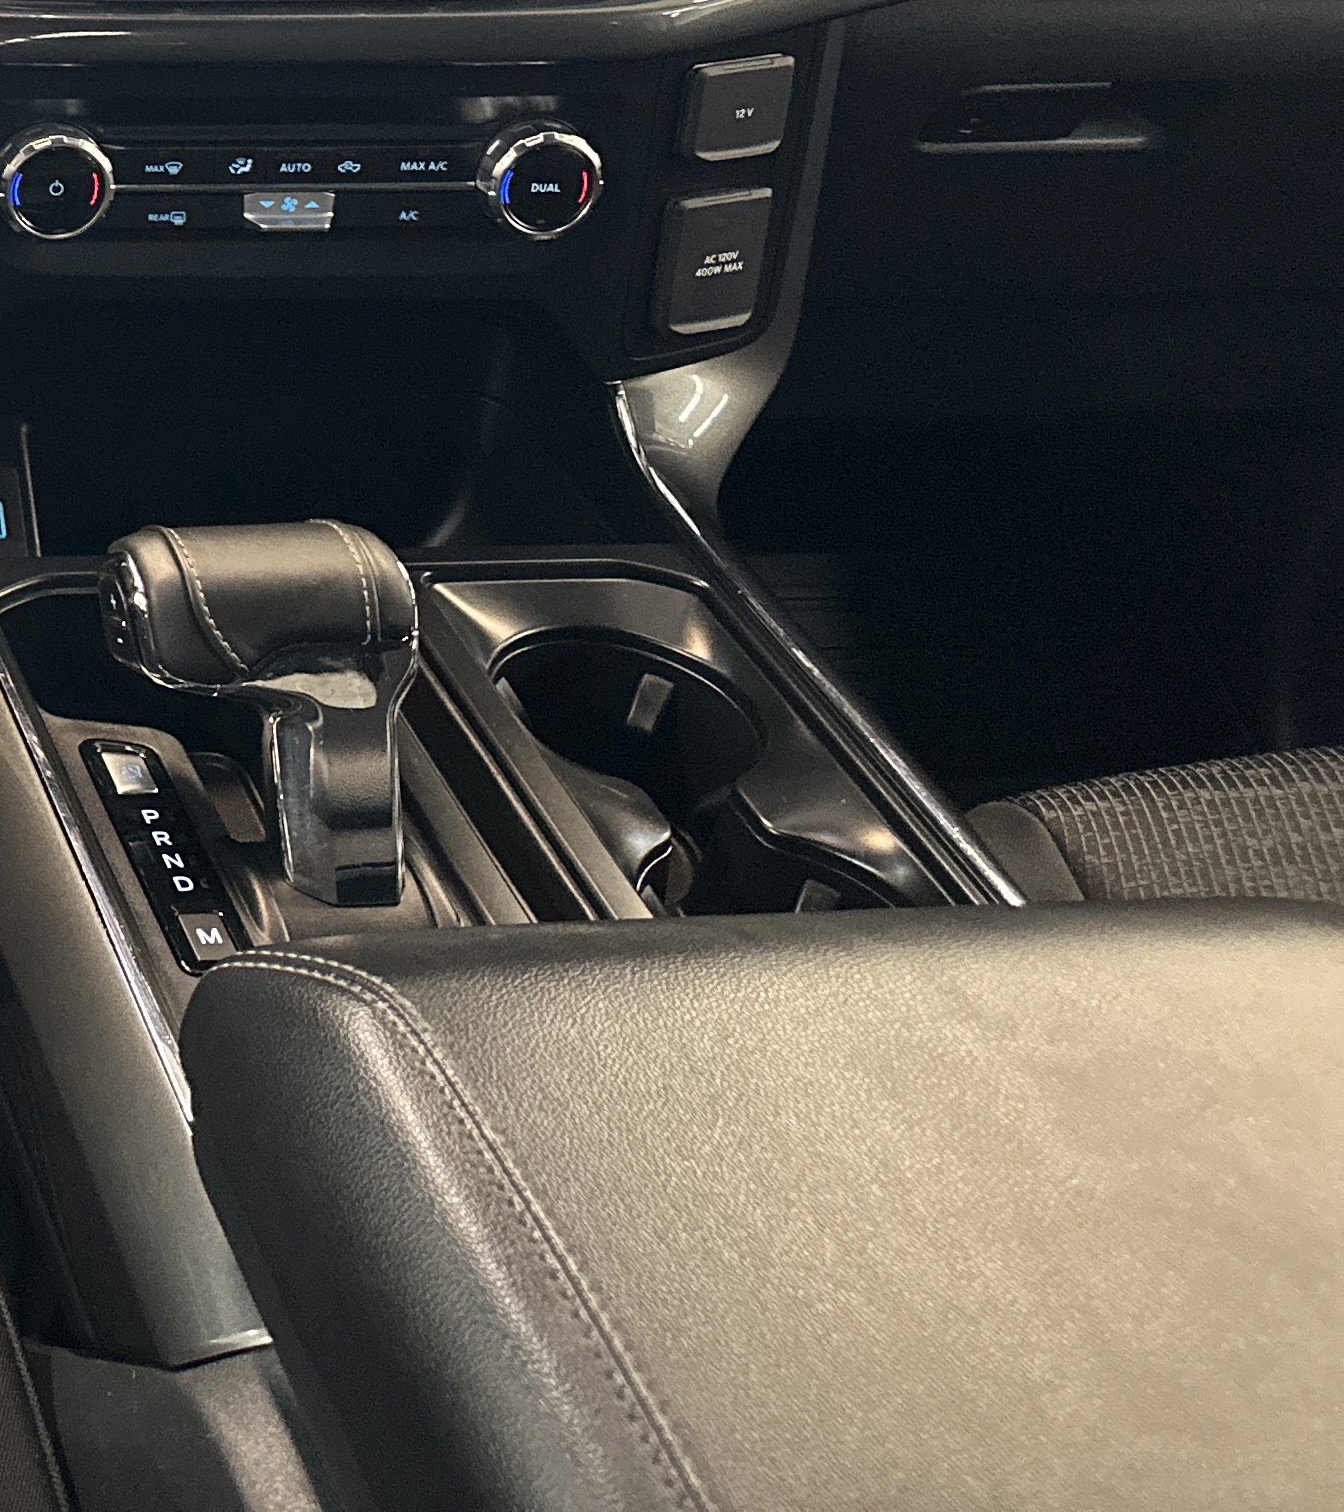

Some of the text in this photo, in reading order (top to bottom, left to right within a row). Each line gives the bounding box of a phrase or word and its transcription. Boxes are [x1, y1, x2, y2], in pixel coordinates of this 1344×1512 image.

[144, 164, 164, 173] MAX
[279, 162, 311, 173] AUTO
[400, 160, 449, 172] MAX A/C
[530, 182, 561, 193] DUAL
[147, 213, 170, 222] REAR
[398, 210, 420, 222] A/C
[703, 249, 741, 266] AC 120V
[695, 260, 744, 278] 400W MAX
[140, 808, 160, 825] P
[151, 830, 173, 846] R
[161, 852, 185, 869] N
[172, 875, 194, 892] D
[195, 926, 224, 945] M
